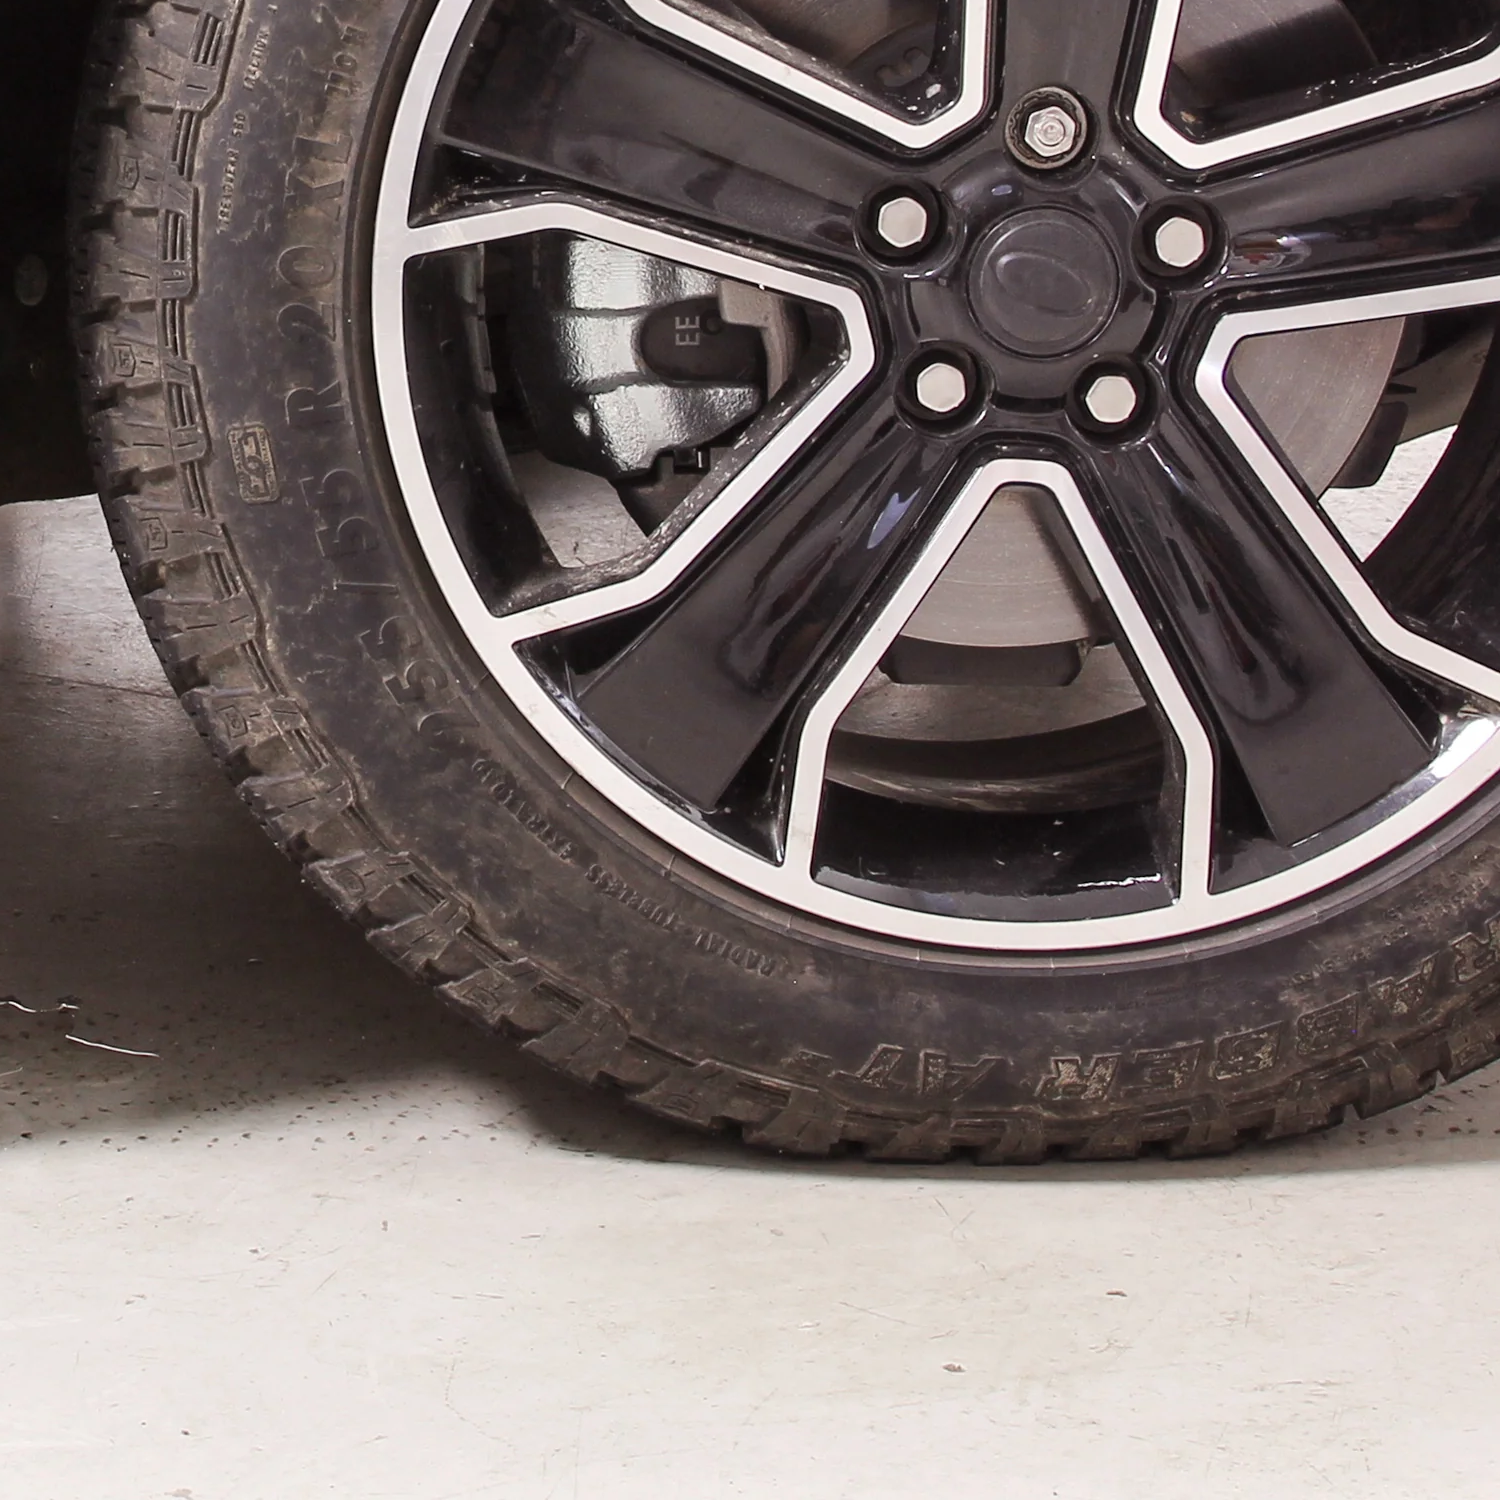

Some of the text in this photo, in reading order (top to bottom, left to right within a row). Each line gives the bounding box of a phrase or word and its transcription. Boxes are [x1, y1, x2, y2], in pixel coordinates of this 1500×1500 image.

[283, 132, 350, 220] XL
[275, 243, 337, 345] 20
[280, 379, 346, 432] R
[299, 466, 481, 748] 255/55
[693, 927, 776, 978] RADIAL
